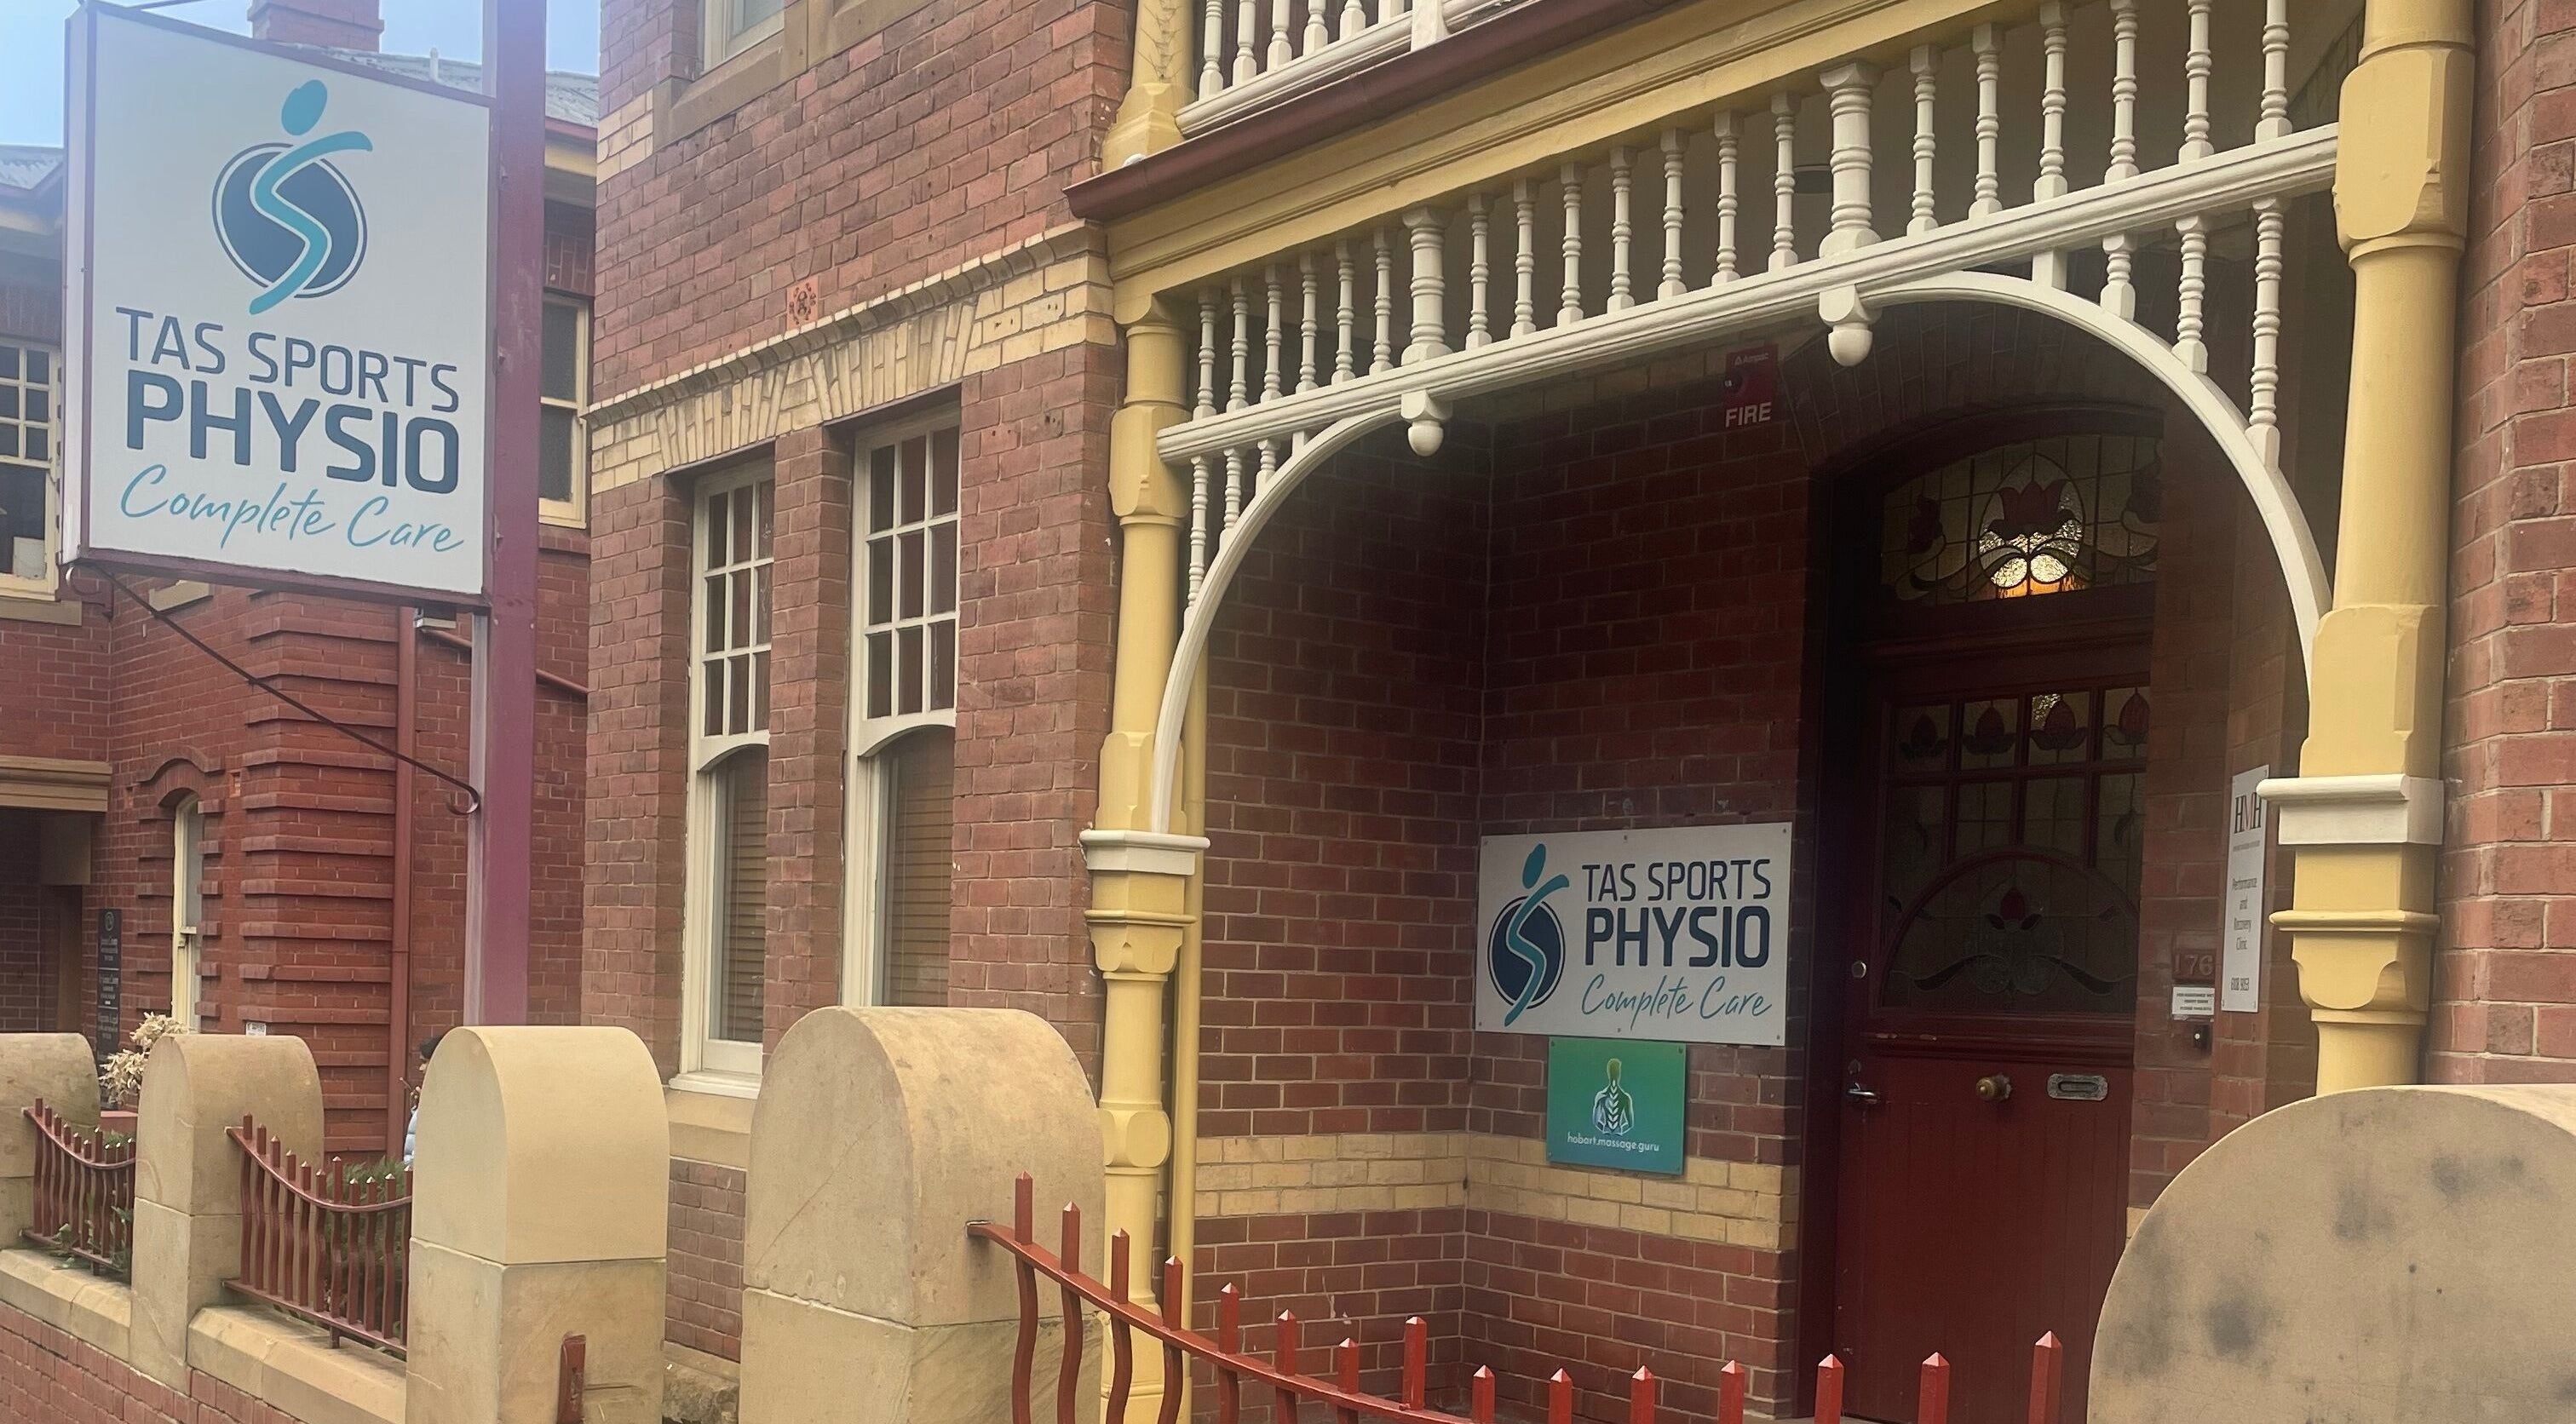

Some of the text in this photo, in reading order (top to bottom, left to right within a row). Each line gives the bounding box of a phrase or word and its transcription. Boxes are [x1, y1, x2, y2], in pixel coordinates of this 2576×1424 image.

[116, 307, 459, 413] TAS SPORTS
[126, 369, 459, 494] PHYSIO
[1725, 401, 1772, 428] FIRE
[120, 463, 464, 552] Complete Care
[1582, 858, 1771, 903] TAS SPORTS
[1584, 905, 1771, 968] PHYSIO
[1581, 973, 1773, 1031] Complete Care
[1567, 1131, 1659, 1152] hobart.massage.guru
